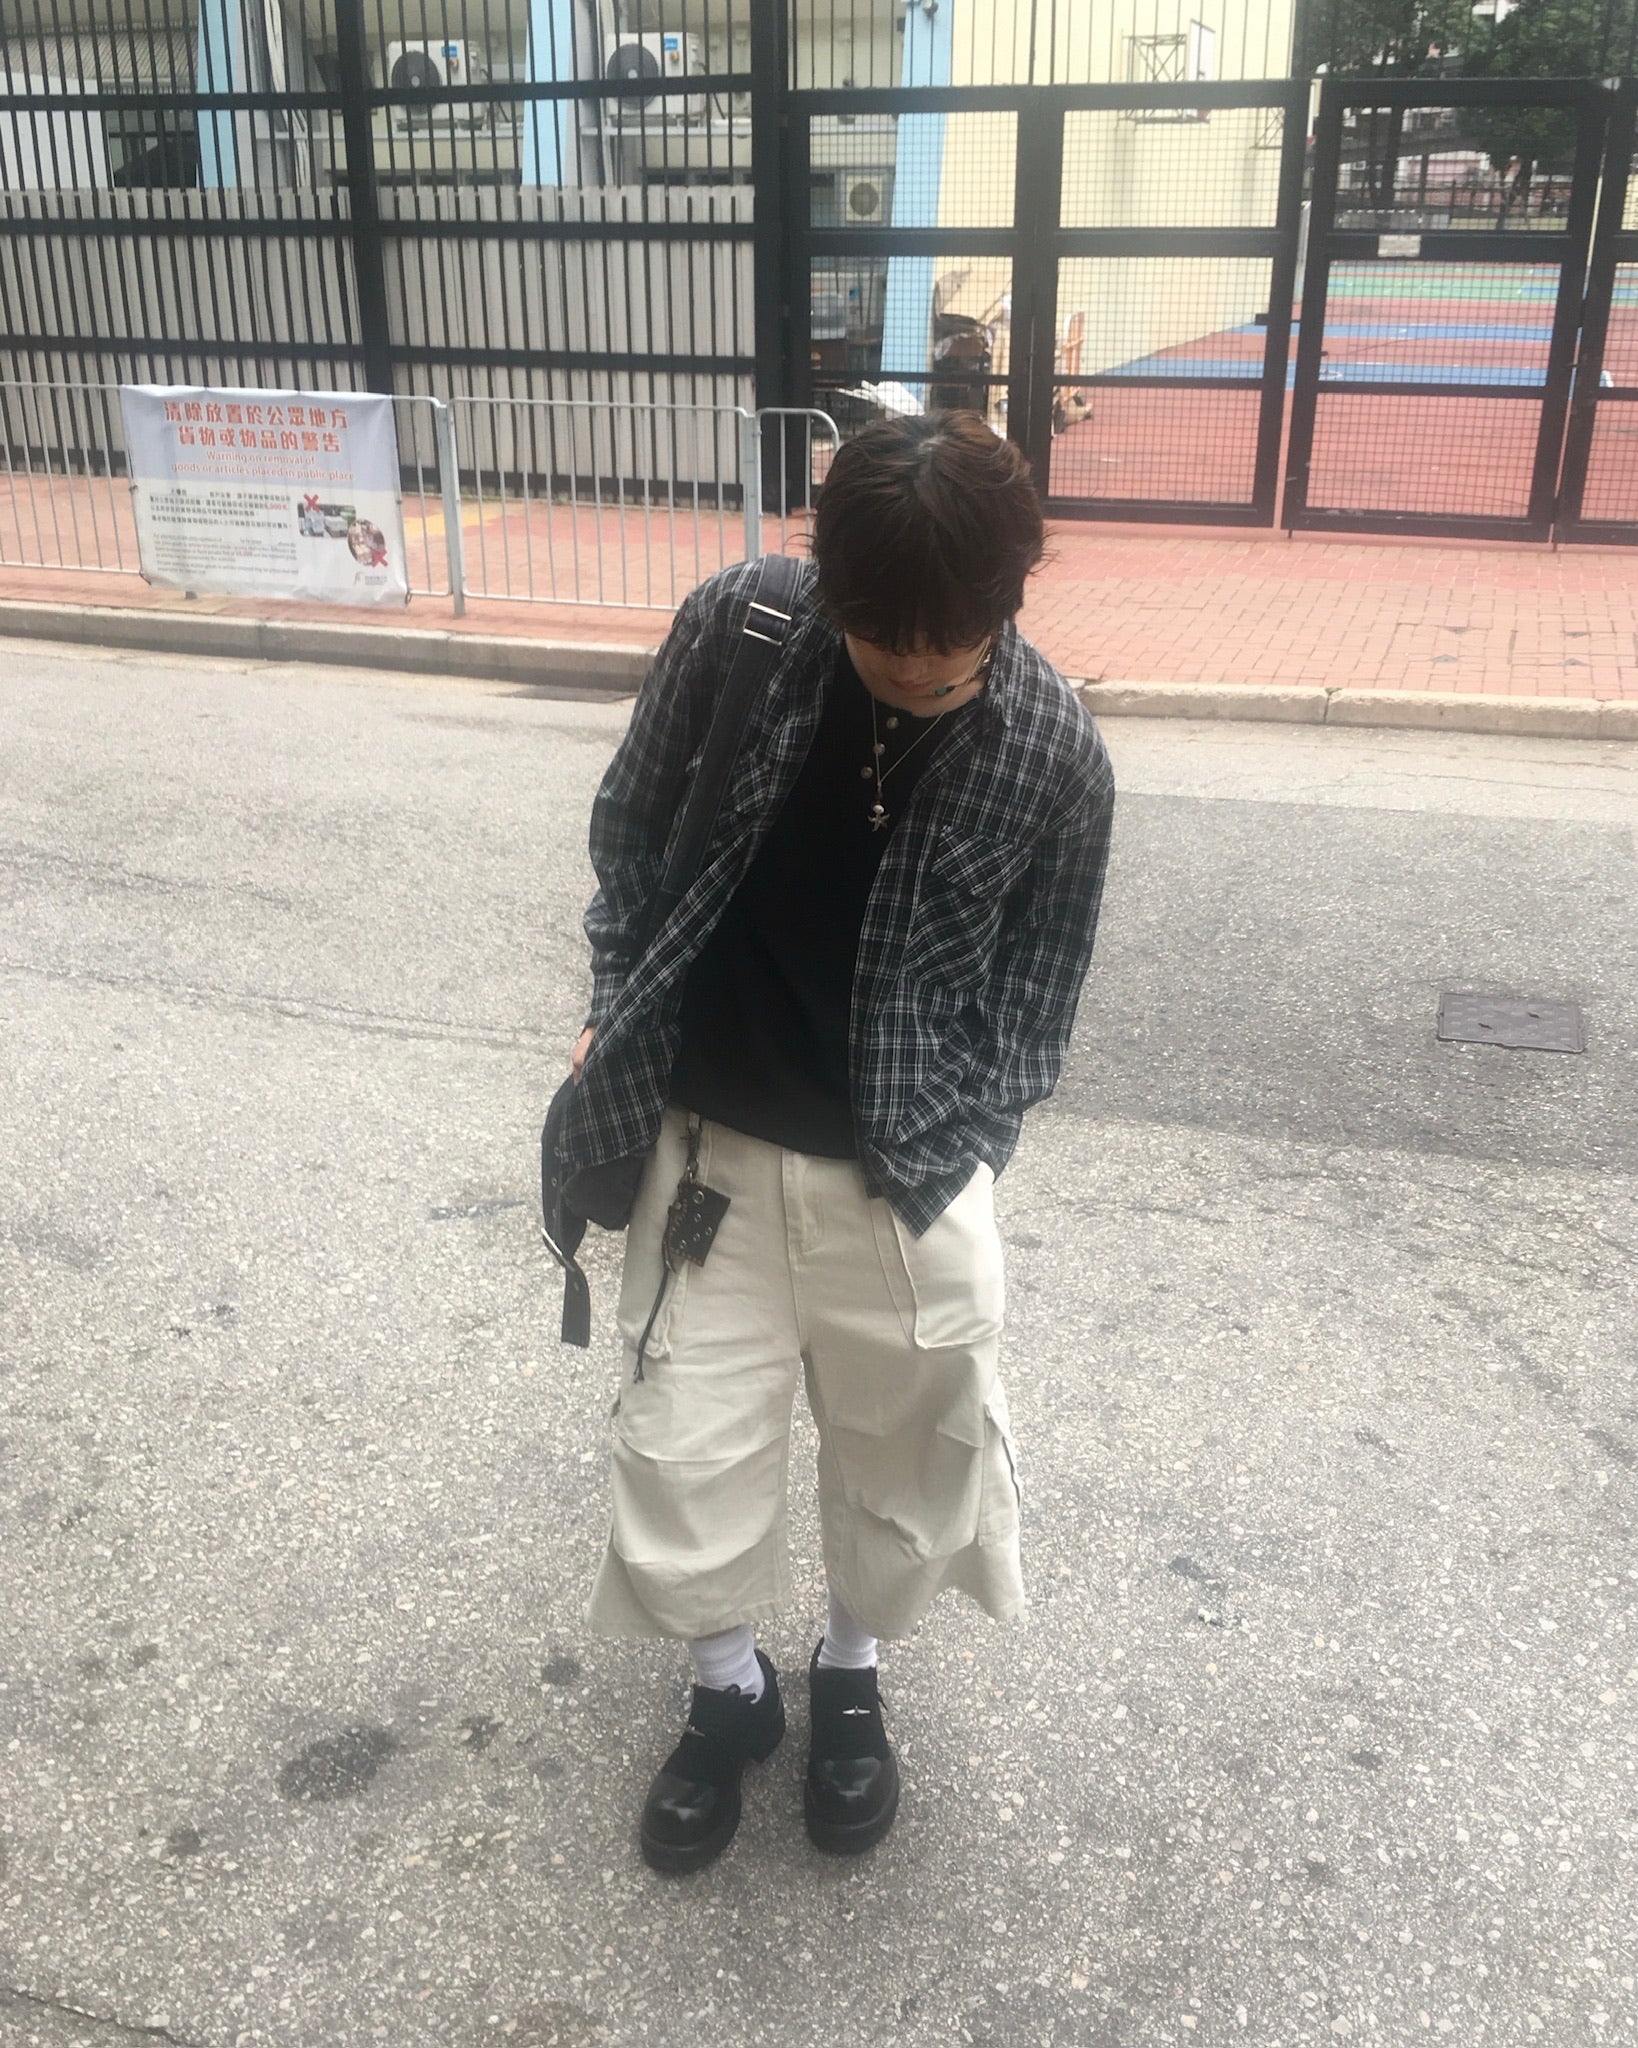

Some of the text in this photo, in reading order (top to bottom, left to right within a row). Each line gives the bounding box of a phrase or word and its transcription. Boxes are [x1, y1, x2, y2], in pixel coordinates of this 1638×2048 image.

[164, 401, 348, 428] 清除放置於公眾地方
[179, 425, 340, 452] 貨物或物品的警告
[207, 450, 315, 465] Warning on removal of
[171, 463, 354, 481] goods or articles placed in public place
